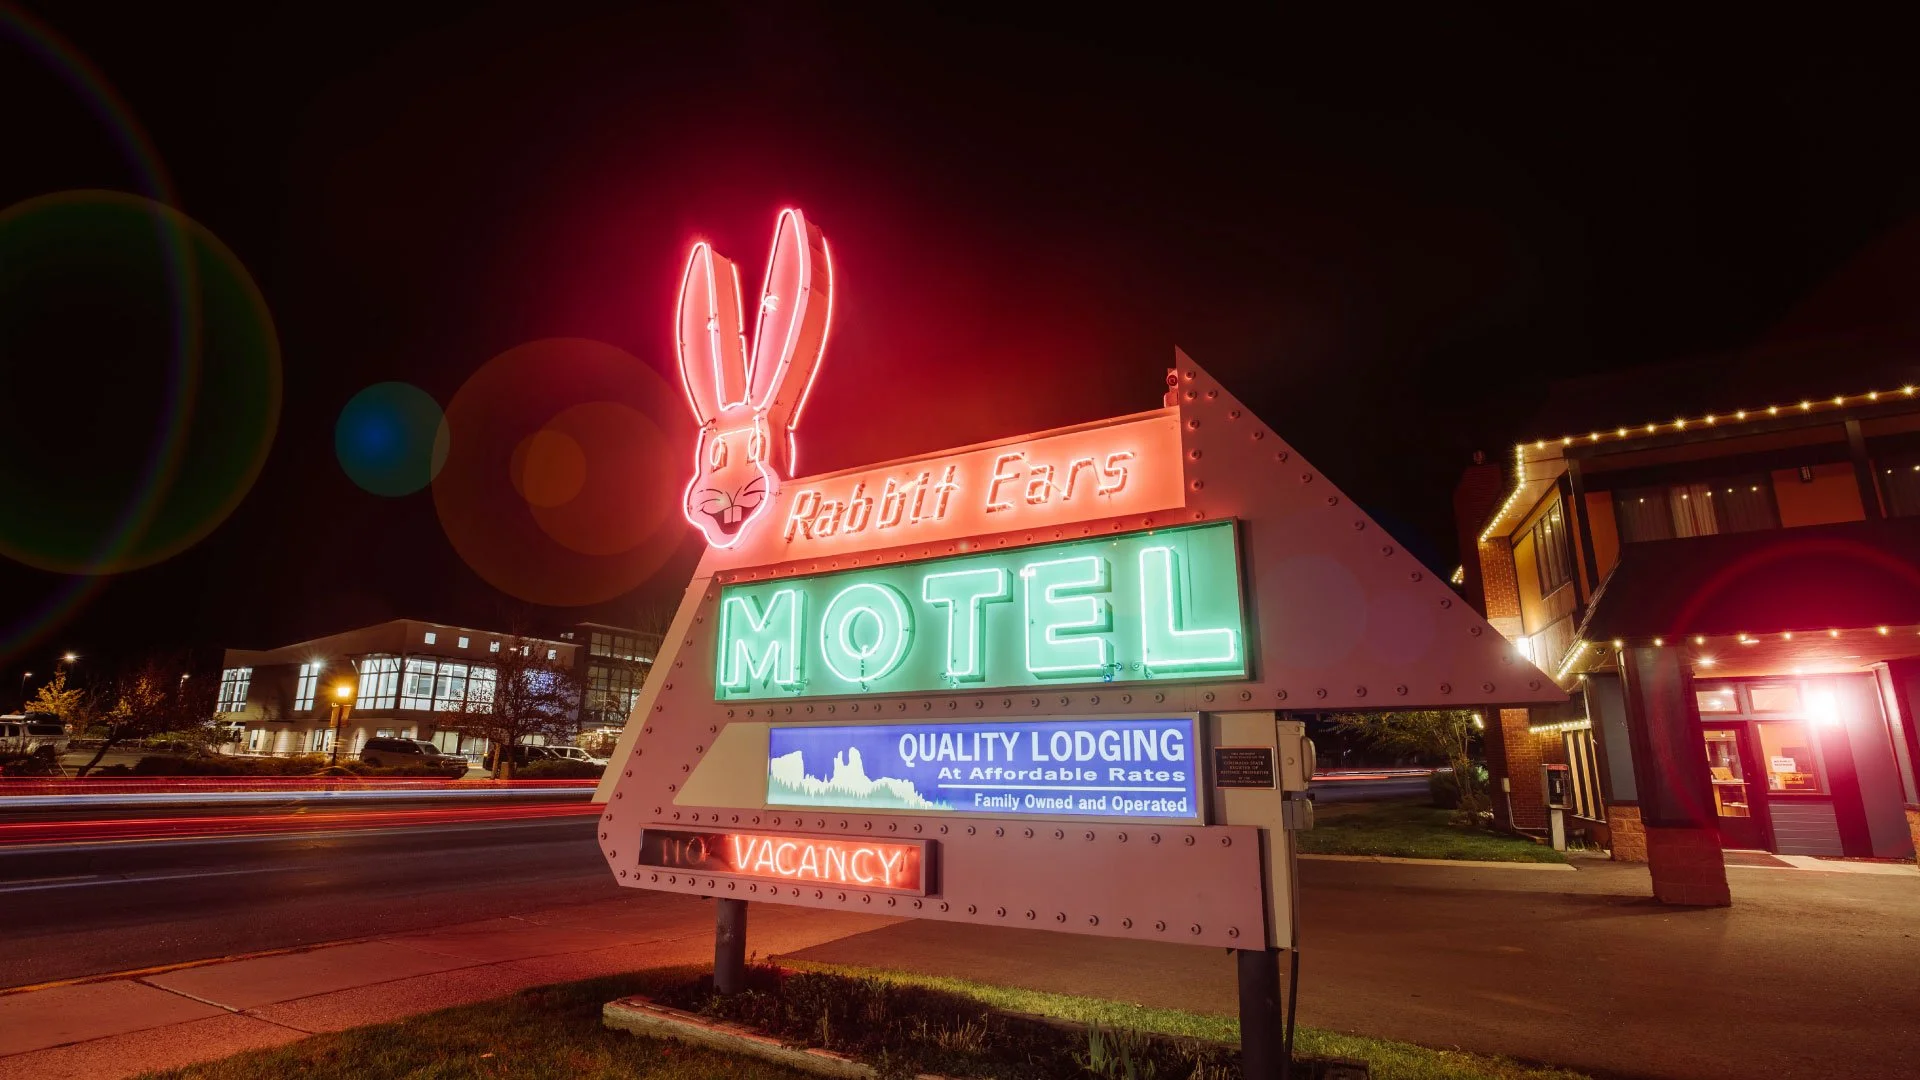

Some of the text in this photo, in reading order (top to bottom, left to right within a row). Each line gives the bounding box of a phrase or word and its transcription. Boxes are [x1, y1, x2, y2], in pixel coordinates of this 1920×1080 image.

[783, 451, 1135, 544] Rabbit Ears
[719, 546, 1238, 693] MOTEL
[898, 728, 1185, 767] QUALITY LODGING
[937, 767, 1186, 782] At Affordable Rates
[974, 793, 1188, 814] Family Owned and Operated
[734, 835, 901, 885] VACANCY
